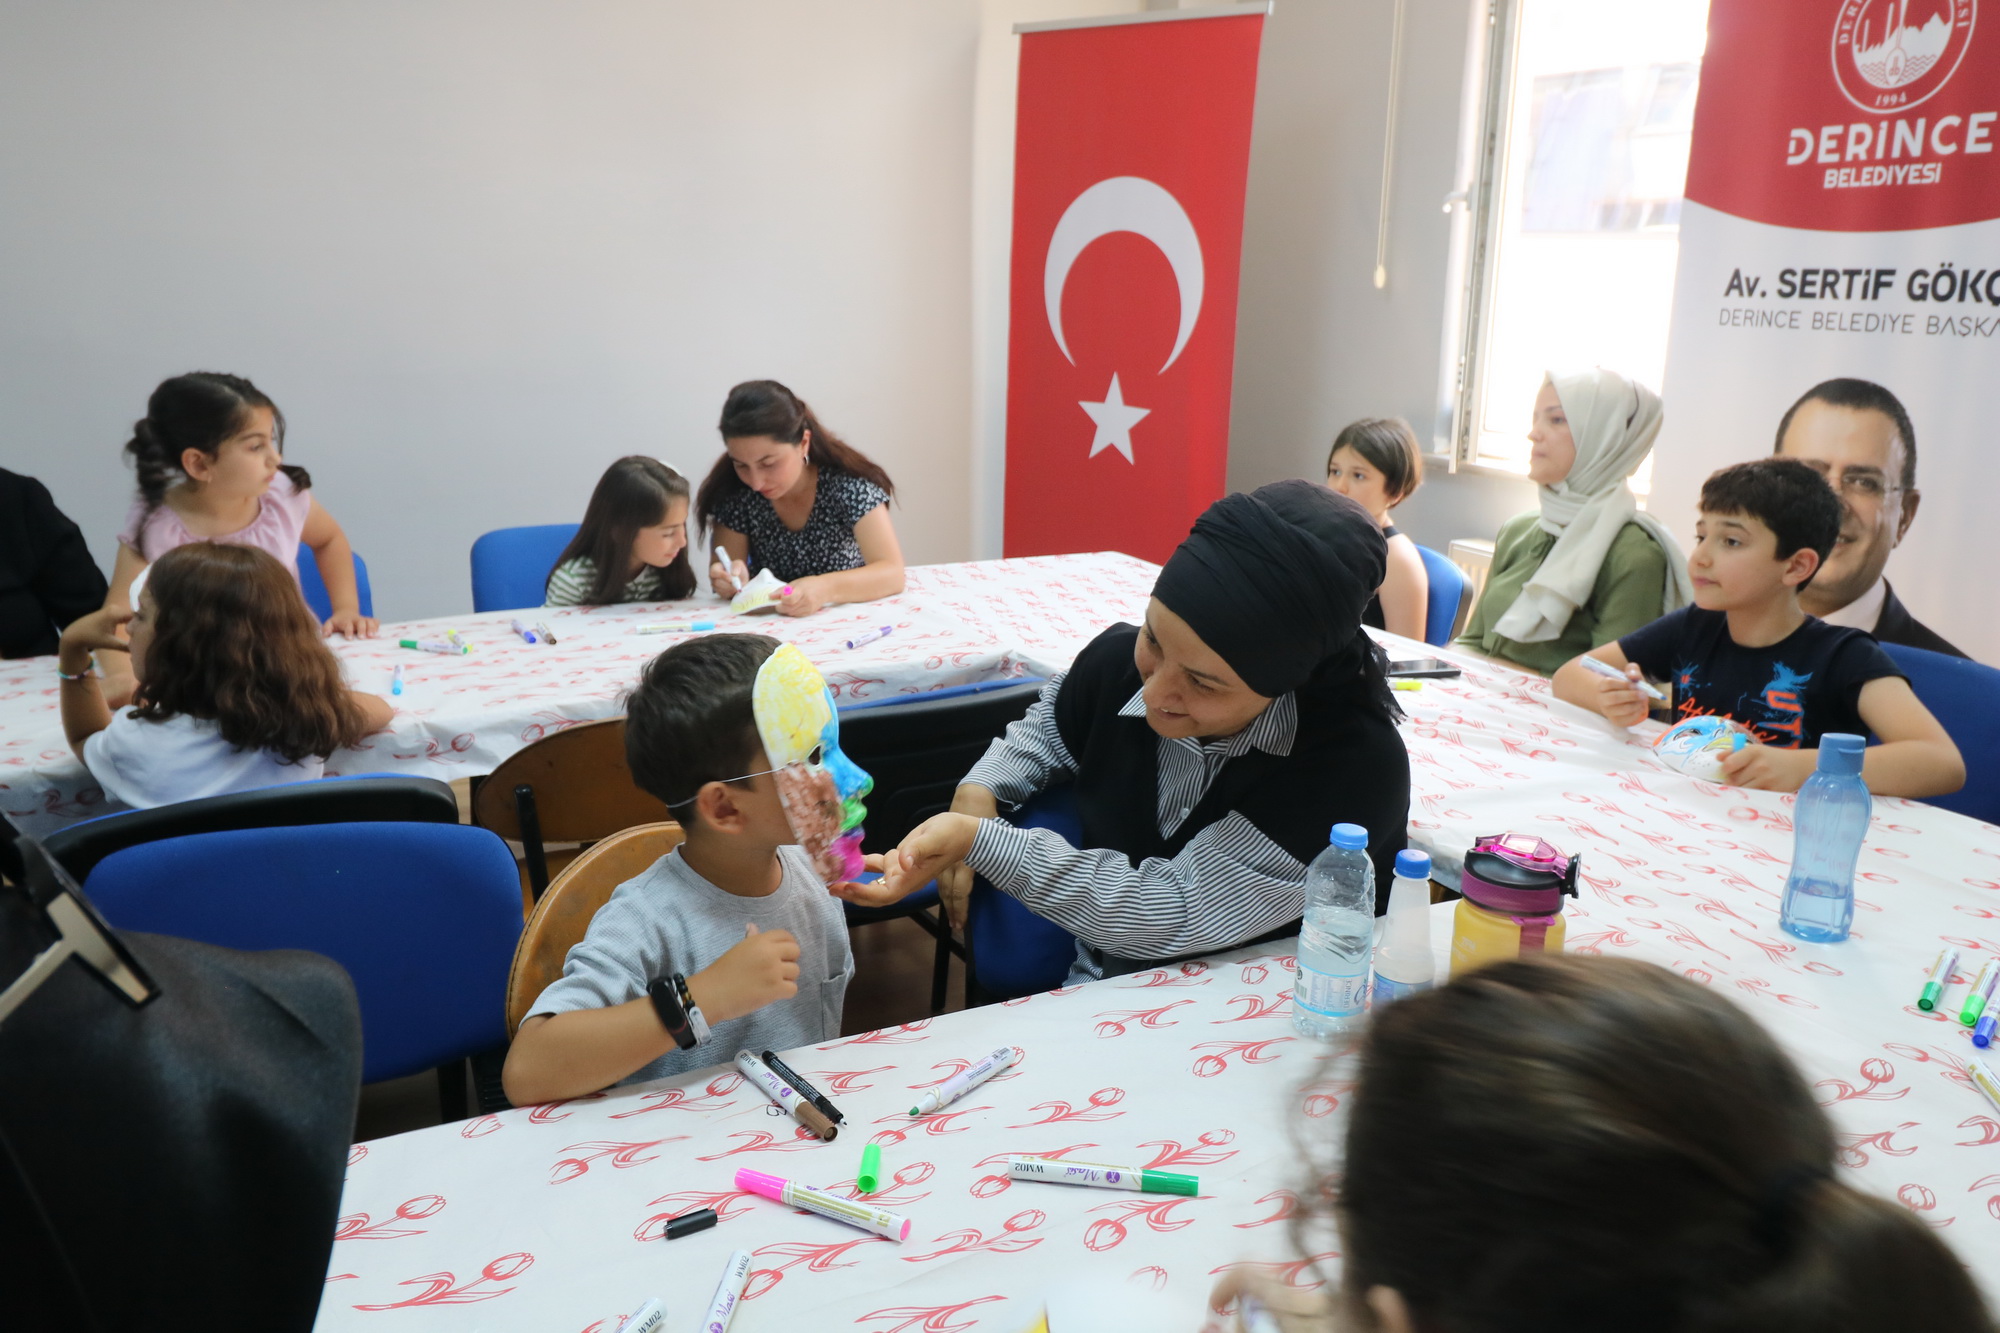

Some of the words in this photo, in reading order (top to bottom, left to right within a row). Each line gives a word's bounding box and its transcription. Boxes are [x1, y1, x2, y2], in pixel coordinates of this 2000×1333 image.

[1875, 91, 1907, 106] 1994
[1786, 111, 1998, 165] DERİNCE
[1823, 163, 1942, 189] BELEDİYESİ
[1723, 268, 1767, 298] Av.
[1777, 267, 1897, 301] SERTİF
[1719, 308, 1802, 329] DERİNCE
[1811, 311, 1915, 334] BELEDİYE
[1014, 1162, 1044, 1173] WM02
[734, 1255, 750, 1278] WM02
[637, 1310, 662, 1333] WM02
